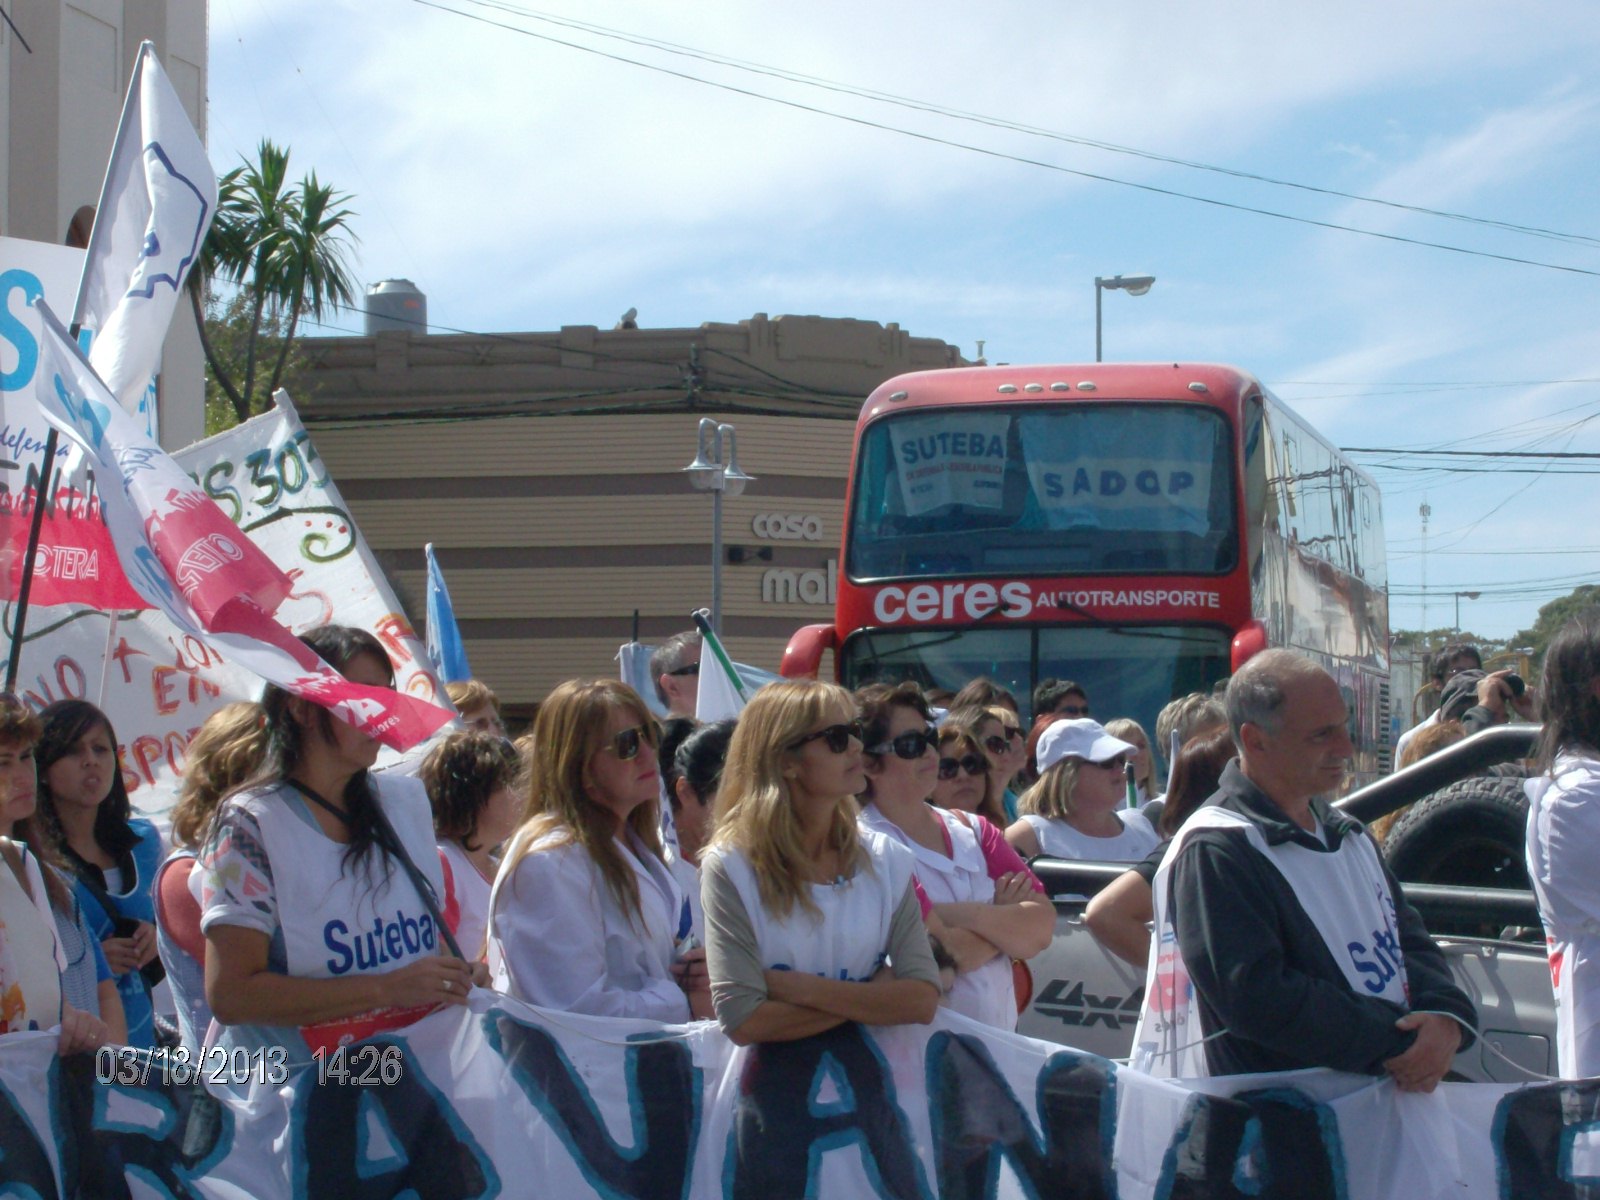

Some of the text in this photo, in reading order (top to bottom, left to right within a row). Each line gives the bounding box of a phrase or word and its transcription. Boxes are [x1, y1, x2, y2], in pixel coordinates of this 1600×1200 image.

[0, 425, 69, 459] defena
[901, 432, 1004, 464] SUTEBA
[1043, 467, 1195, 498] SADOP
[753, 513, 823, 540] casa
[23, 544, 99, 581] CTERA
[873, 582, 1220, 623] ceres AUTOTRANSPORTE
[323, 909, 438, 975] Suteba
